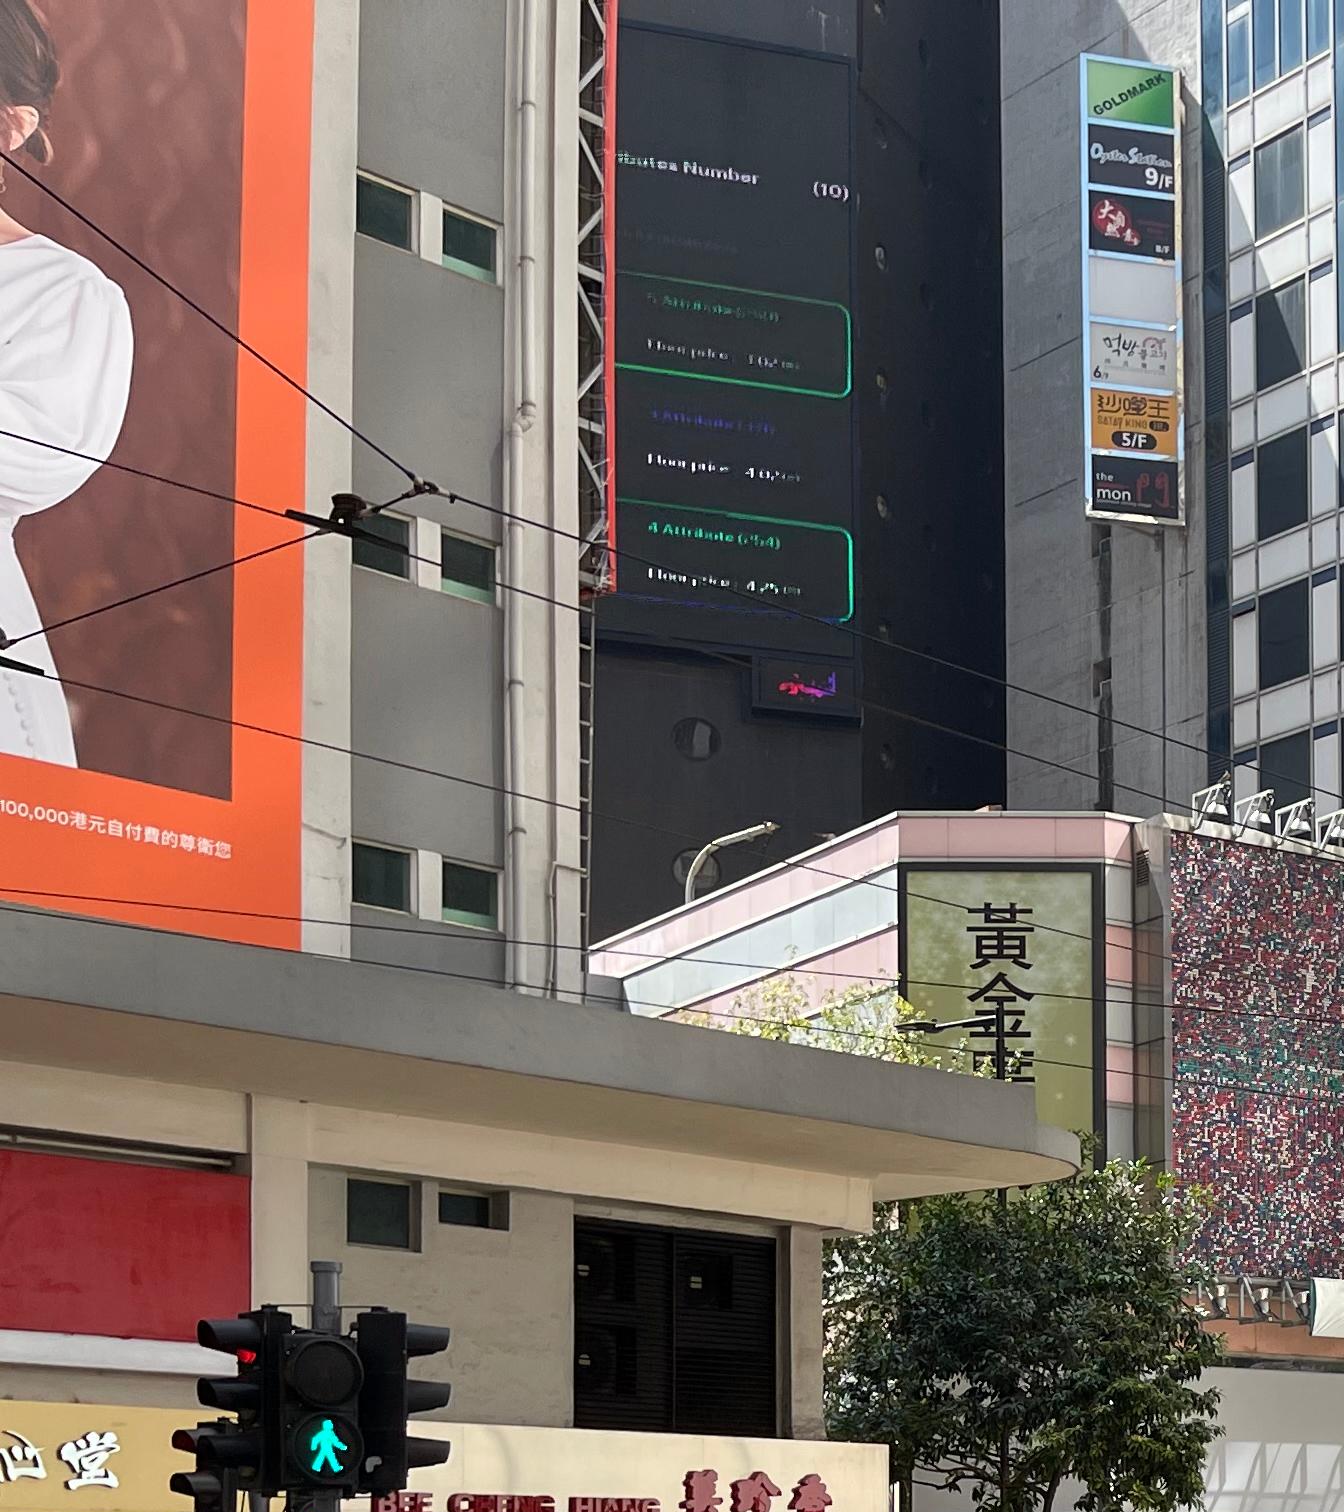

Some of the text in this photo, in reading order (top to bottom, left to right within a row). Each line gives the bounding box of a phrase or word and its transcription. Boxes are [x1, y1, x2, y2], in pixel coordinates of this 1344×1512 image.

[1093, 73, 1167, 117] GOLDMARK
[683, 160, 760, 185] Number
[812, 181, 850, 202] (10)
[1143, 167, 1174, 190] 9/F
[1125, 418, 1148, 430] KING
[1121, 431, 1148, 448] 5/F
[1096, 471, 1115, 483] the
[1096, 487, 1132, 502] mon
